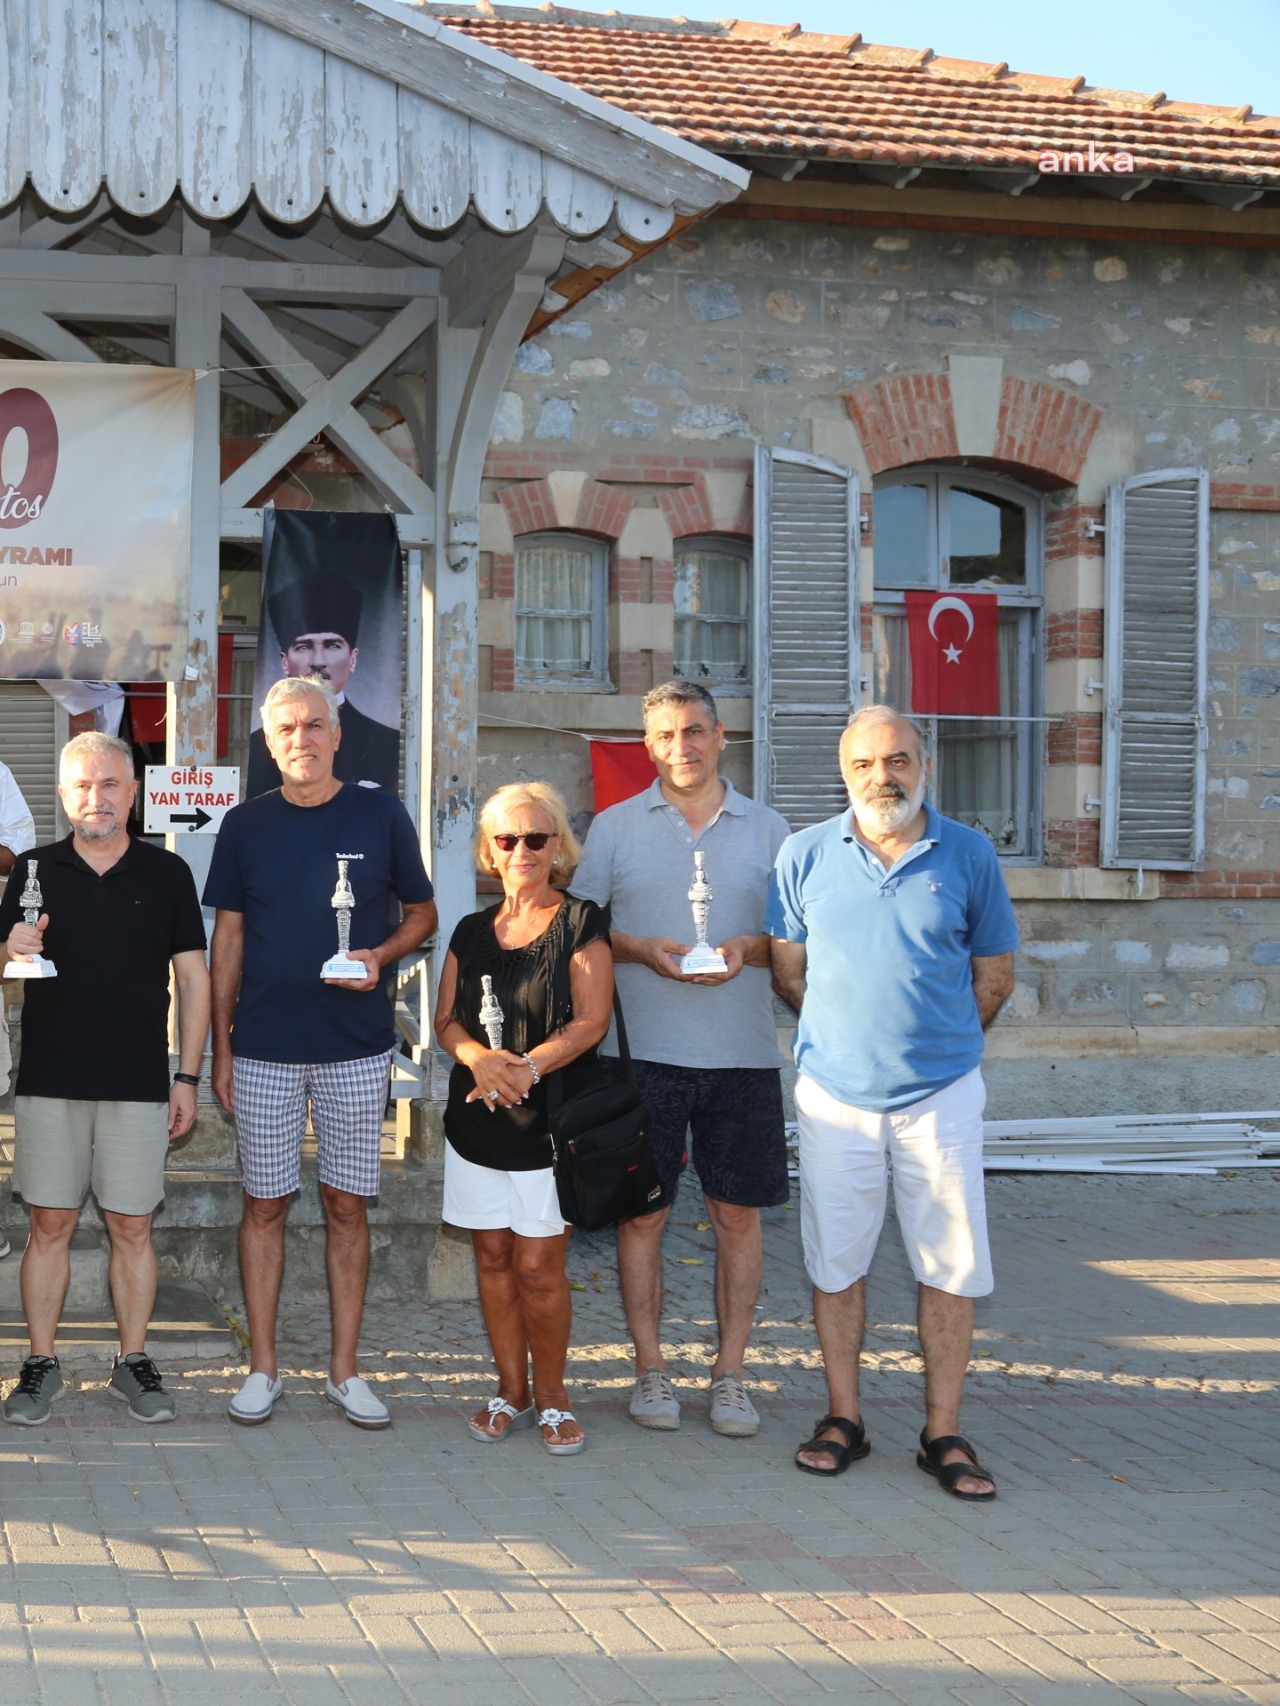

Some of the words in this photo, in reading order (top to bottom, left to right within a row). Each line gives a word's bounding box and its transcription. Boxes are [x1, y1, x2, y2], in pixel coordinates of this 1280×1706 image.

[171, 769, 213, 788] GİRİŞ
[149, 792, 180, 806] YAN
[185, 792, 235, 806] TARAF
